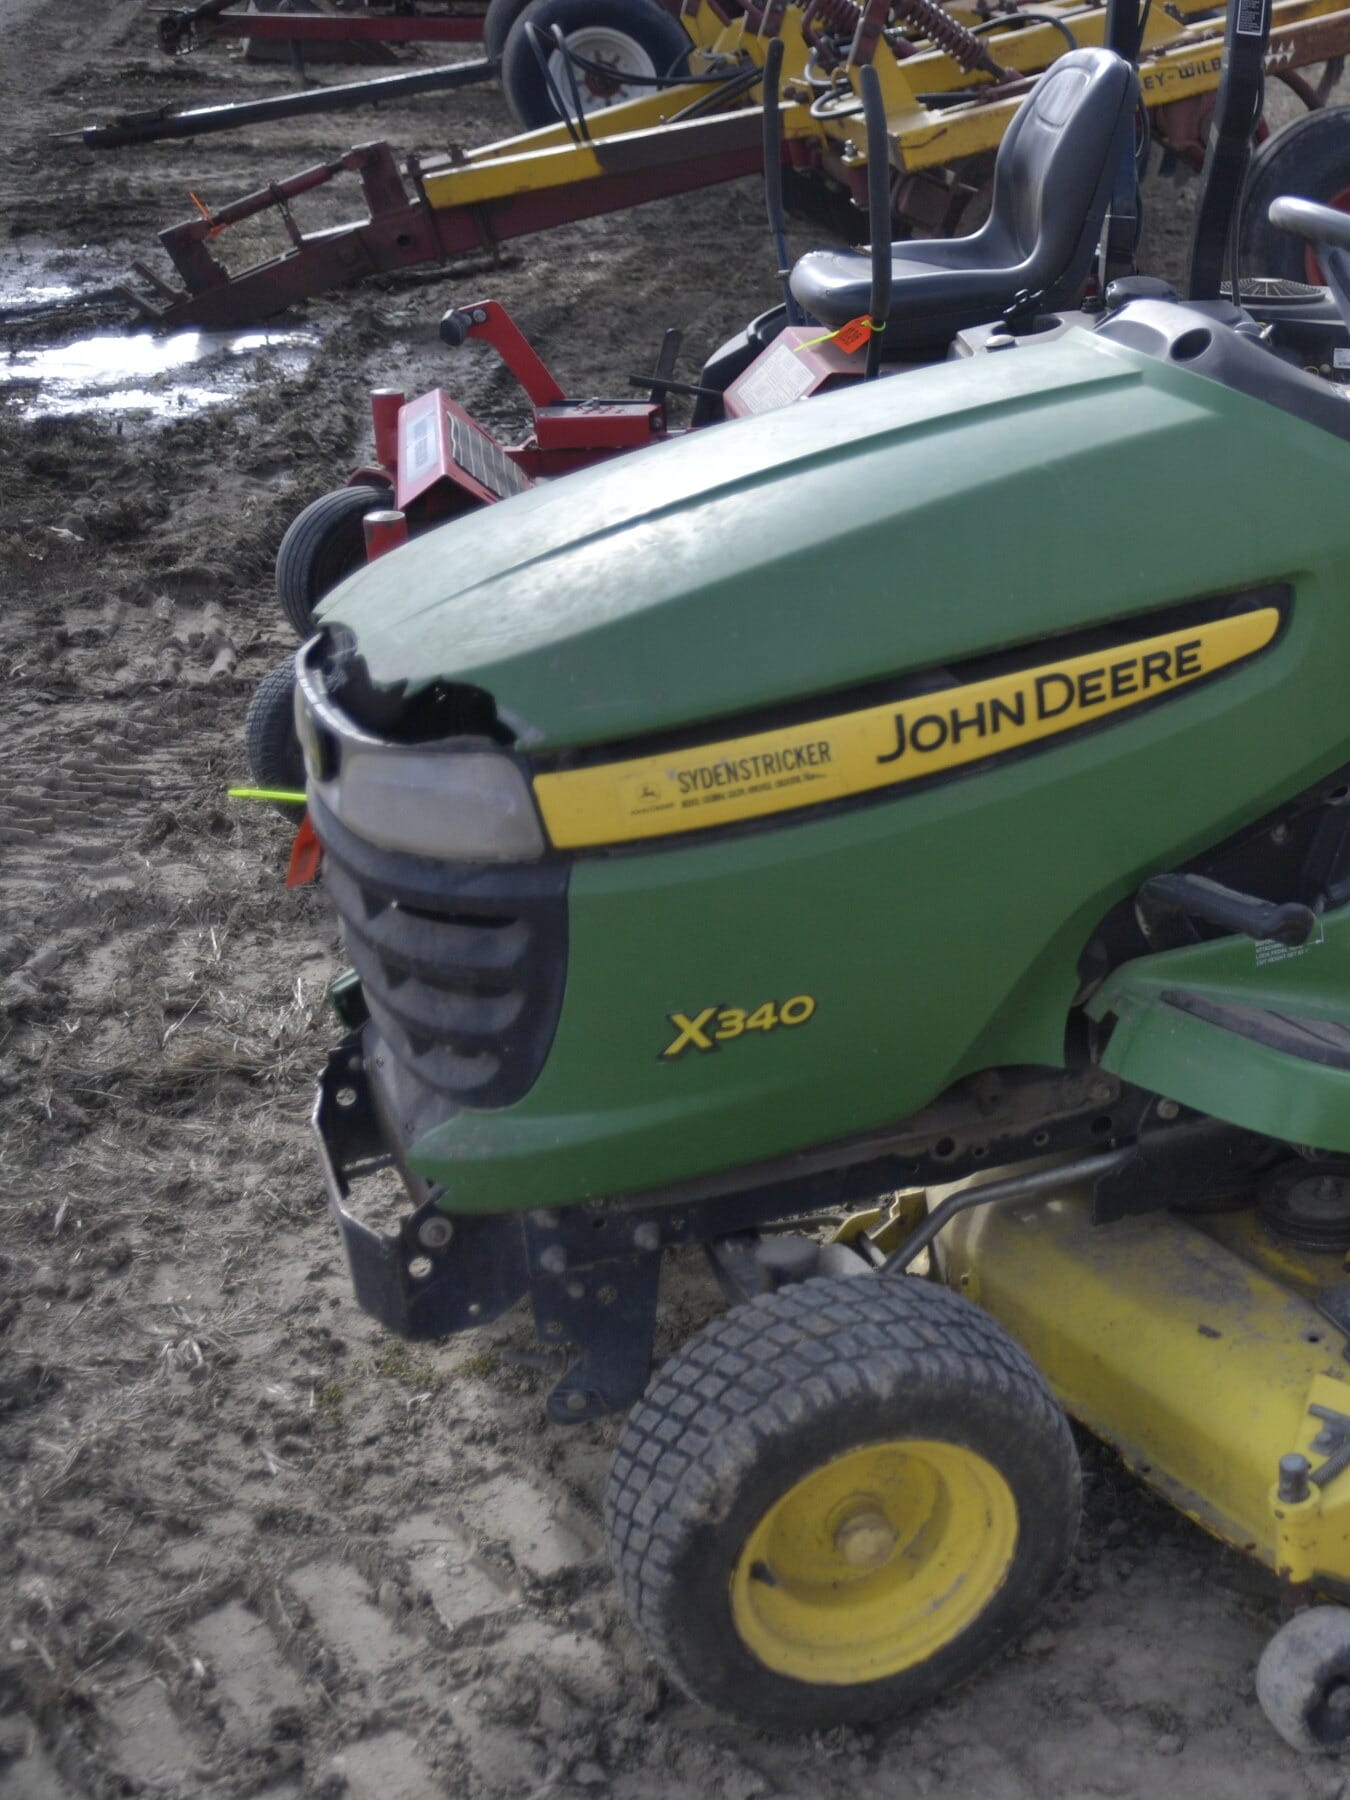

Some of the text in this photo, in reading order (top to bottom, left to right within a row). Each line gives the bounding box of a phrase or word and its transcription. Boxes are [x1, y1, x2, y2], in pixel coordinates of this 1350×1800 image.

[876, 639, 1202, 764] JOHN DEERE
[677, 740, 832, 794] SYDENSTRICKER
[660, 994, 816, 1057] X340
